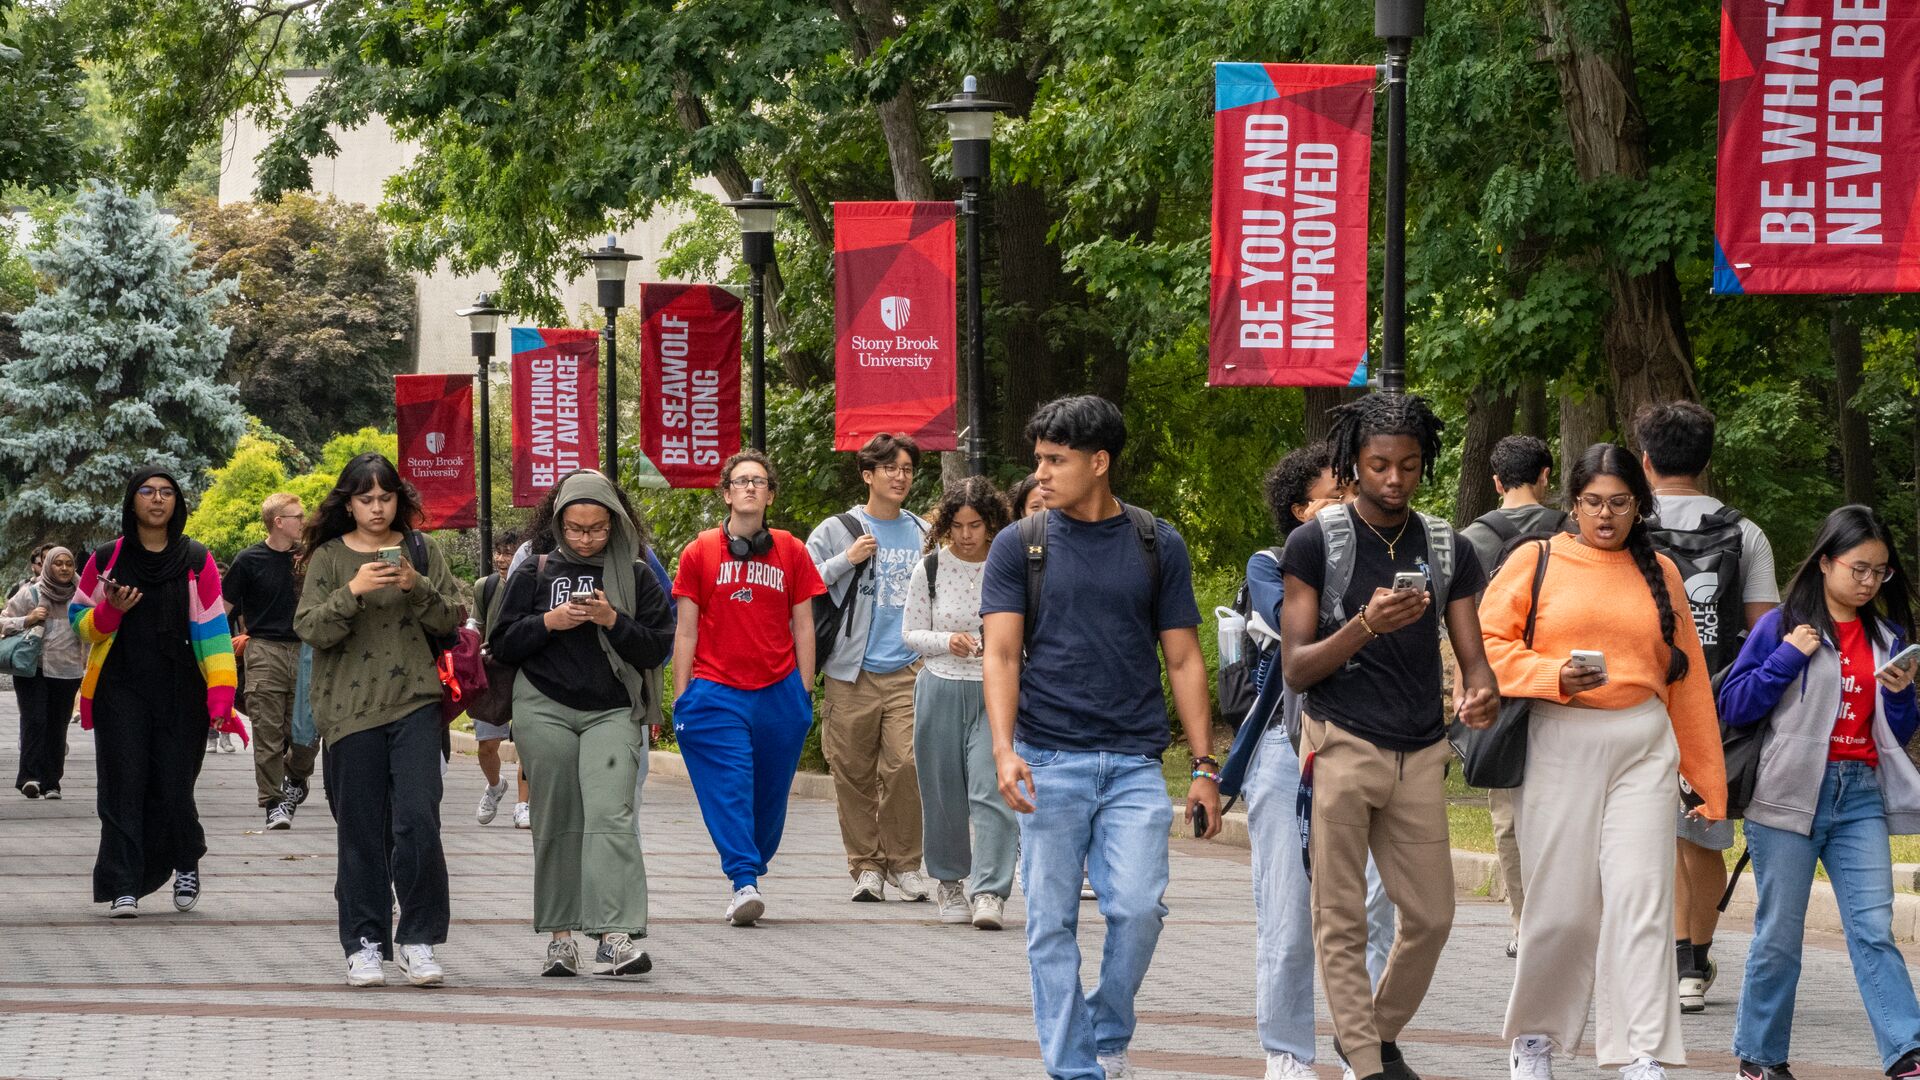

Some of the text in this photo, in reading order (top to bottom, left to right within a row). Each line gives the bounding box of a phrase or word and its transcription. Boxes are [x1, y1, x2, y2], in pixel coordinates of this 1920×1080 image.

[1826, 0, 1888, 245] NEVER BE
[1239, 113, 1289, 349] BE YOU AND
[1291, 142, 1338, 349] IMPROVED
[1760, 180, 1817, 245] BE
[851, 335, 940, 353] Stony Brook
[858, 352, 933, 371] University
[531, 359, 554, 487] BE ANYTHING
[556, 354, 580, 480] UT AVERAGE
[661, 313, 689, 465] BE SEAWOLF
[691, 370, 720, 466] STRONG
[407, 456, 464, 468] Stony Brook
[412, 467, 460, 479] University
[746, 560, 785, 592] BROOK
[1704, 604, 1719, 645] FACE
